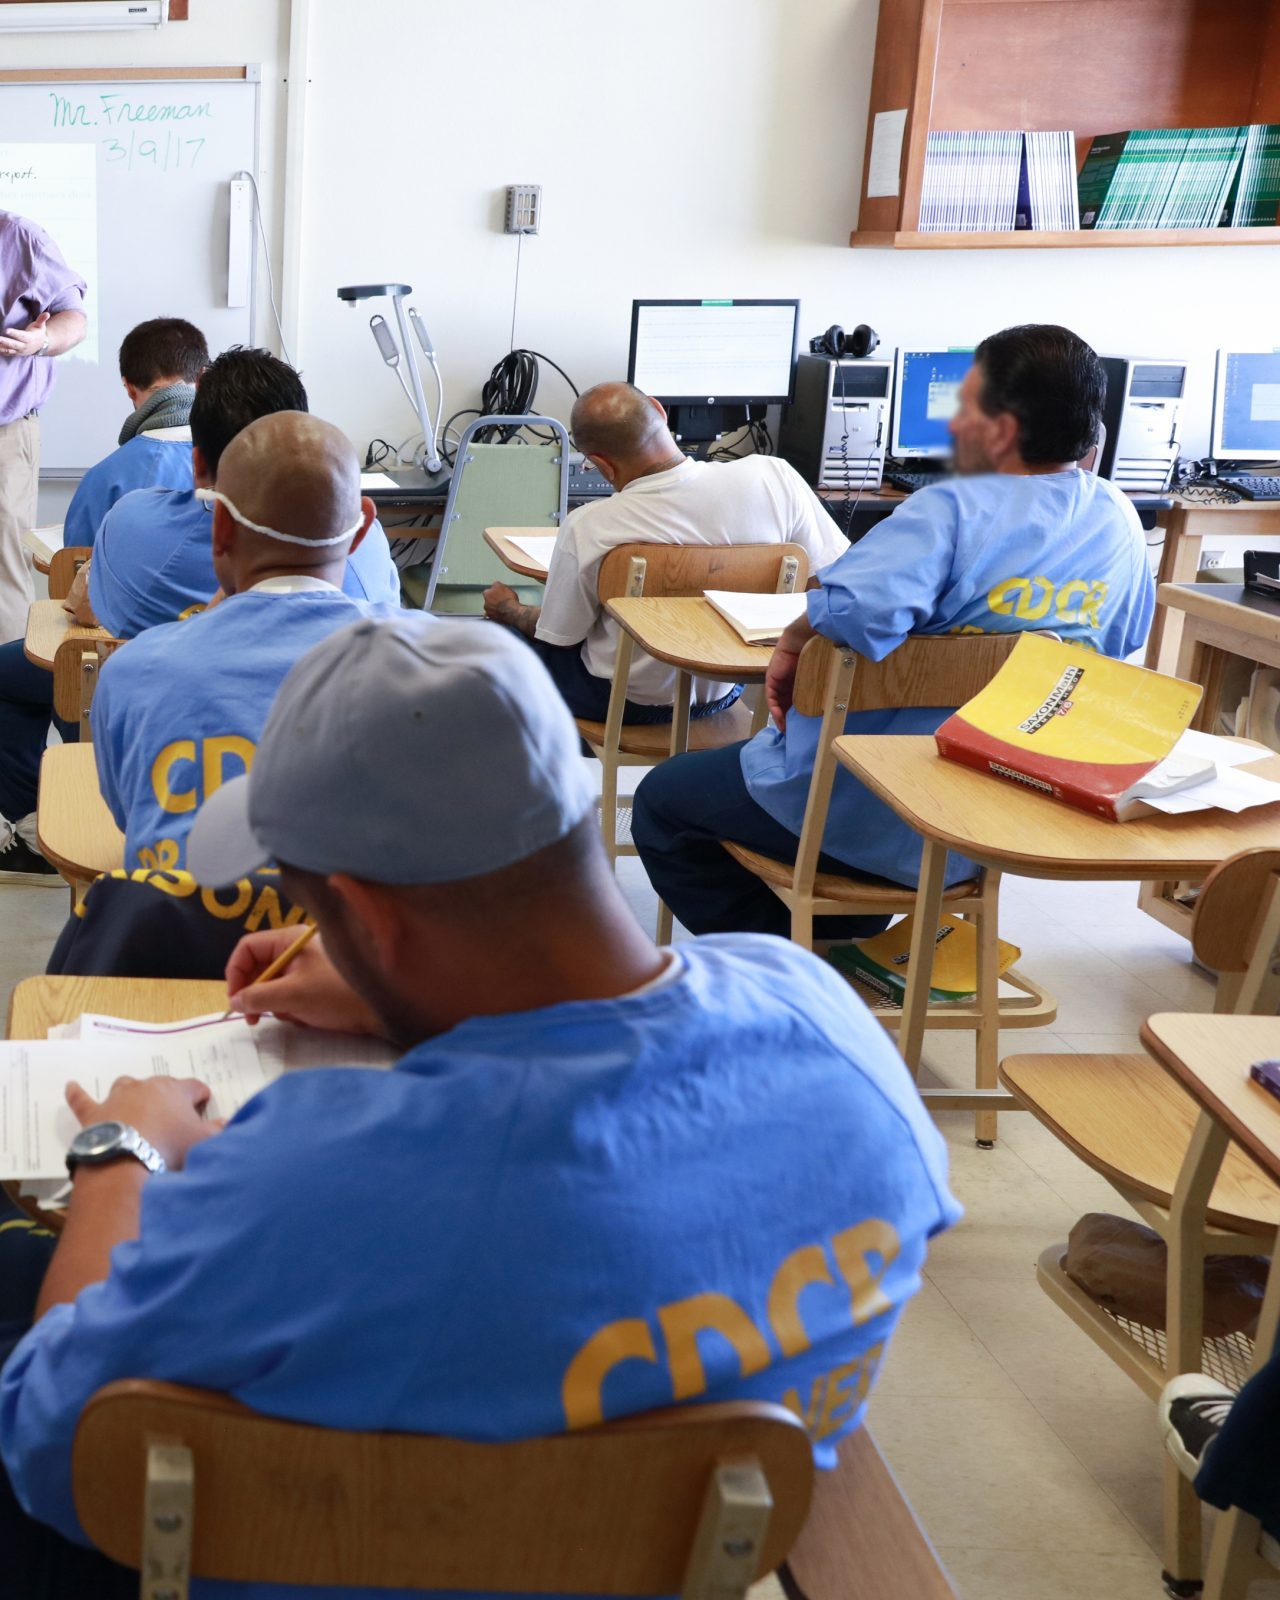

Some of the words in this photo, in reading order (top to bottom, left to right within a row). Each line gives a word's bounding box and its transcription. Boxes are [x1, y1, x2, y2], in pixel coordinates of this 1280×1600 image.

[49, 92, 98, 127] Mr.
[100, 94, 216, 127] Freeman
[102, 130, 206, 172] 3/9/17
[0, 167, 38, 184] report.
[987, 575, 1109, 629] CDCR
[561, 1217, 901, 1431] CDCR
